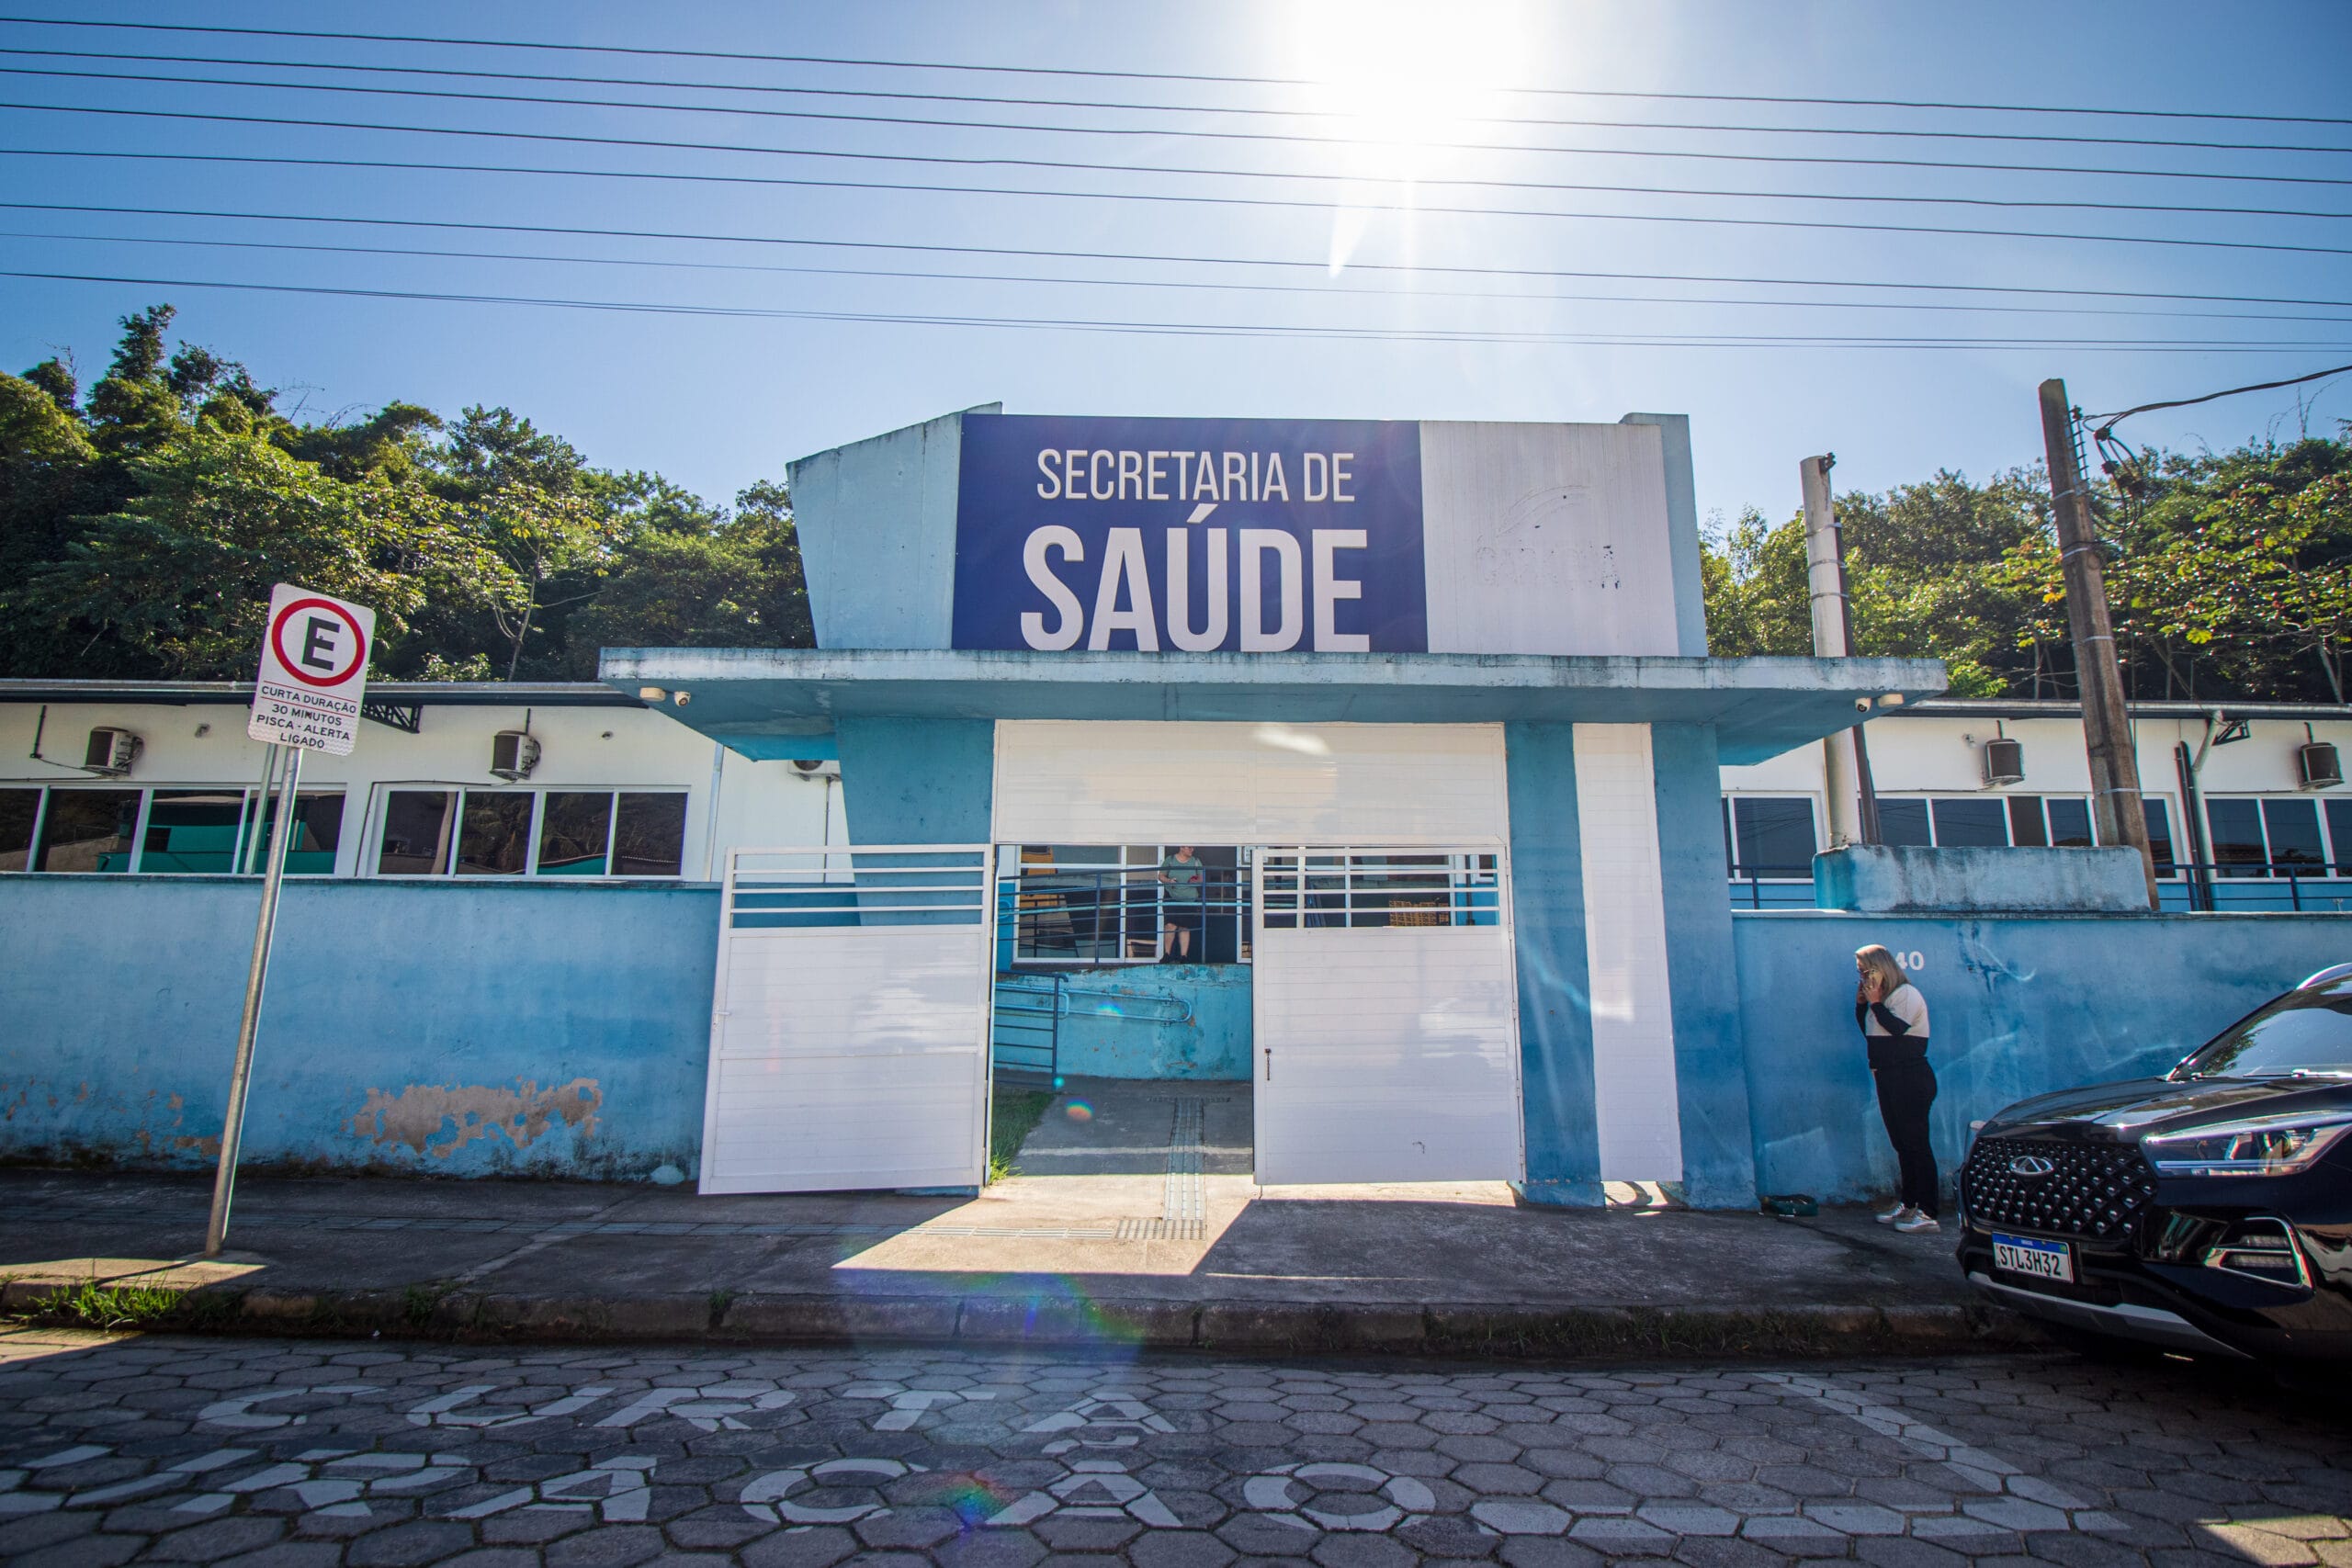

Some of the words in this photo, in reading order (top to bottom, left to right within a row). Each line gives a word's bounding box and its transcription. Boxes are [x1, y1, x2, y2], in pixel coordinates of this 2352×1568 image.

[1036, 448, 1290, 502] SECRETARIA
[1303, 452, 1356, 502] DE
[1020, 502, 1371, 652] SAÚDE
[301, 615, 341, 671] E
[261, 685, 300, 703] CURTA
[303, 694, 357, 714] DURAÇÃO
[256, 714, 295, 729] PISCA
[303, 723, 351, 741] ALERTA
[272, 704, 288, 715] 30
[290, 709, 343, 727] MINUTOS
[279, 732, 325, 749] LIGADO
[1998, 1246, 2062, 1277] STL3H32
[198, 1385, 1180, 1433] CURTA
